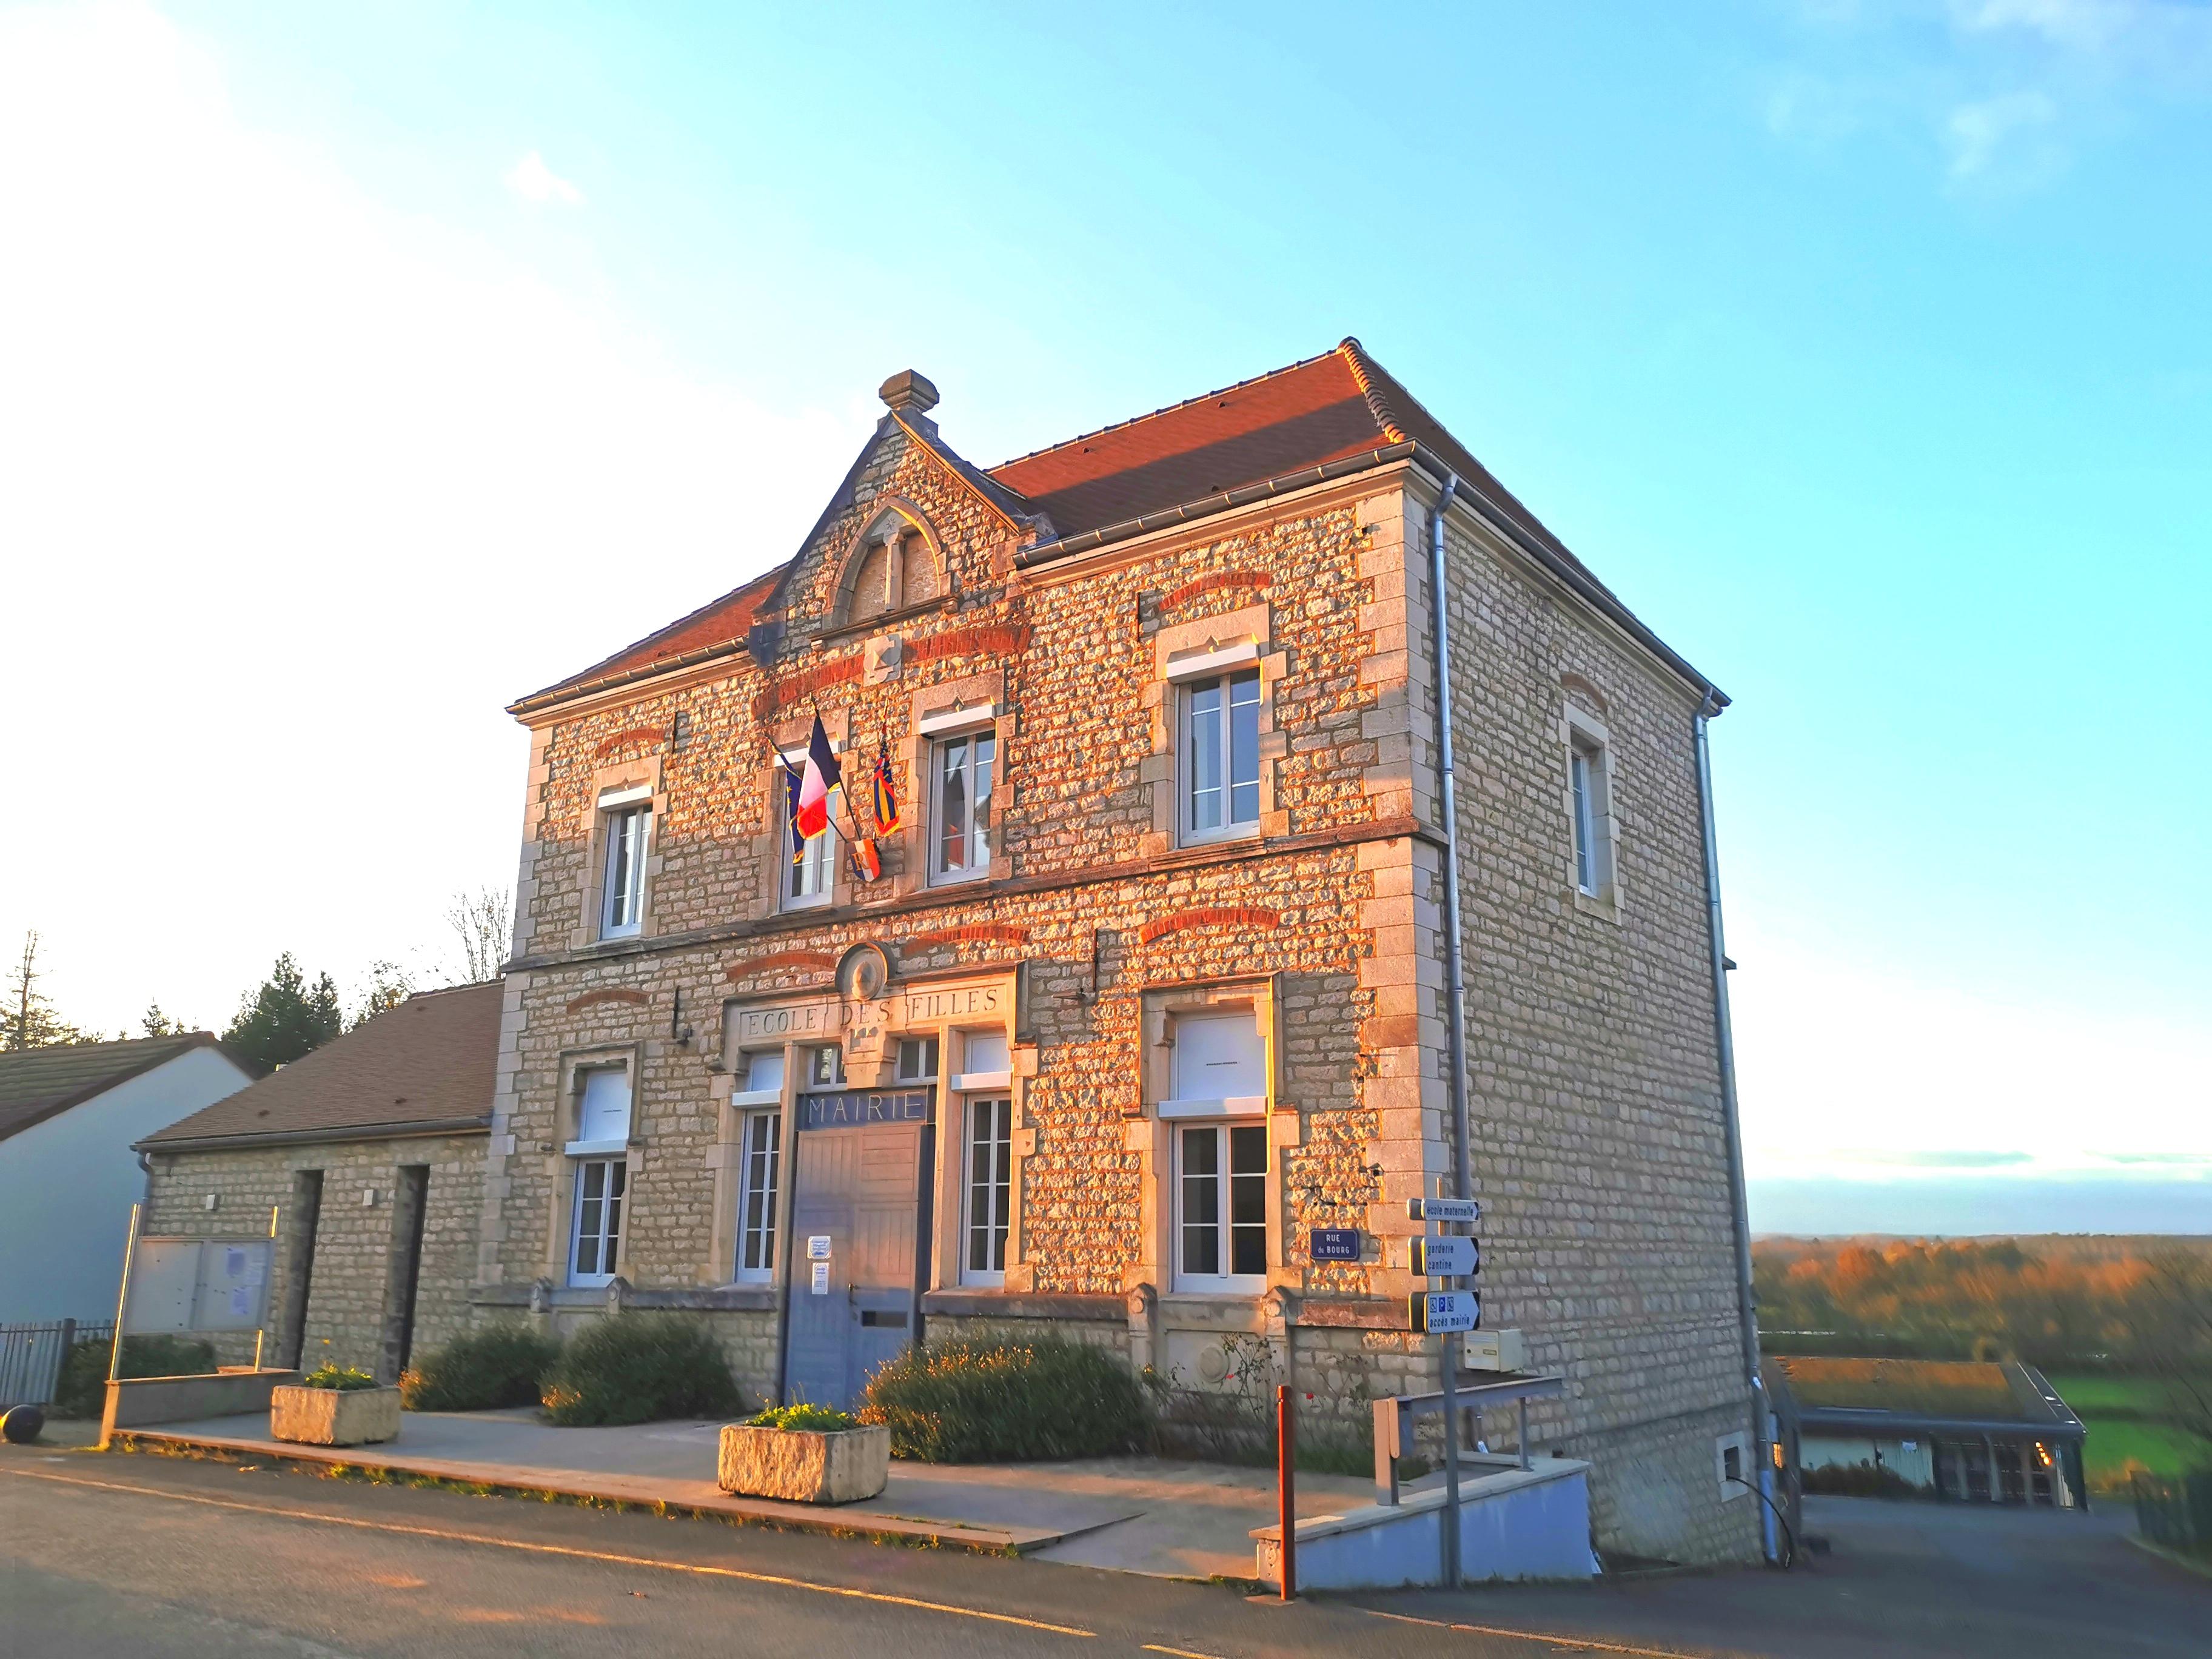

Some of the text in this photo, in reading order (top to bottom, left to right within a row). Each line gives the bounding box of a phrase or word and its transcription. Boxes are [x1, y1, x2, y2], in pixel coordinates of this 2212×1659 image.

[748, 989, 997, 1036] ECOLE DES FILLES
[809, 1091, 921, 1123] MAIRIE
[1444, 1205, 1473, 1216] maternelle
[1326, 1234, 1340, 1242] RUE
[1327, 1245, 1350, 1254] BOURG
[1427, 1243, 1454, 1256] garderie
[1427, 1259, 1452, 1270] cantine
[1429, 1313, 1470, 1328] accès mairie
